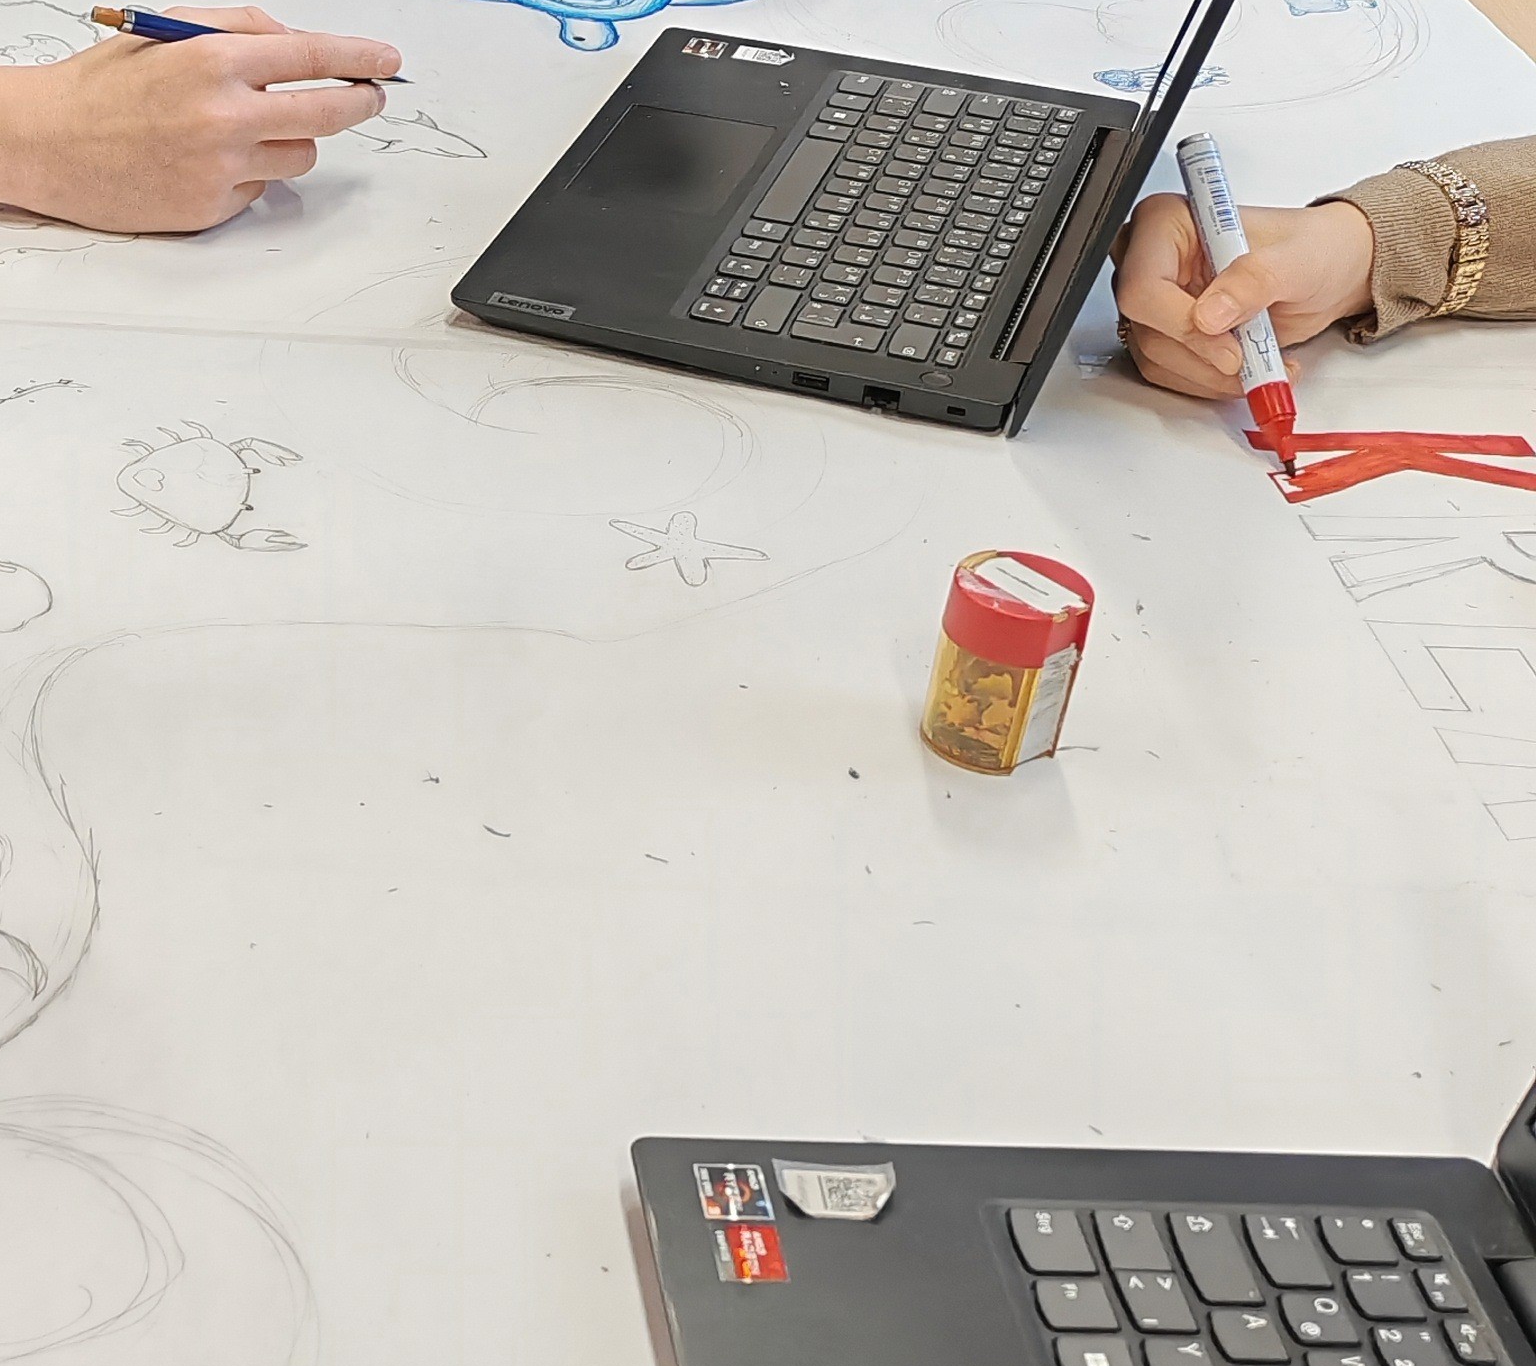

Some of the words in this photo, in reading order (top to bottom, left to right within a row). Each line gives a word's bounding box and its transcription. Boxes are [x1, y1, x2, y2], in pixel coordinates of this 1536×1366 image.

[497, 296, 565, 315] Lenovo
[1312, 1295, 1341, 1315] Q
[1242, 1312, 1267, 1329] A
[1378, 1328, 1403, 1343] 2
[1177, 1343, 1205, 1357] Y
